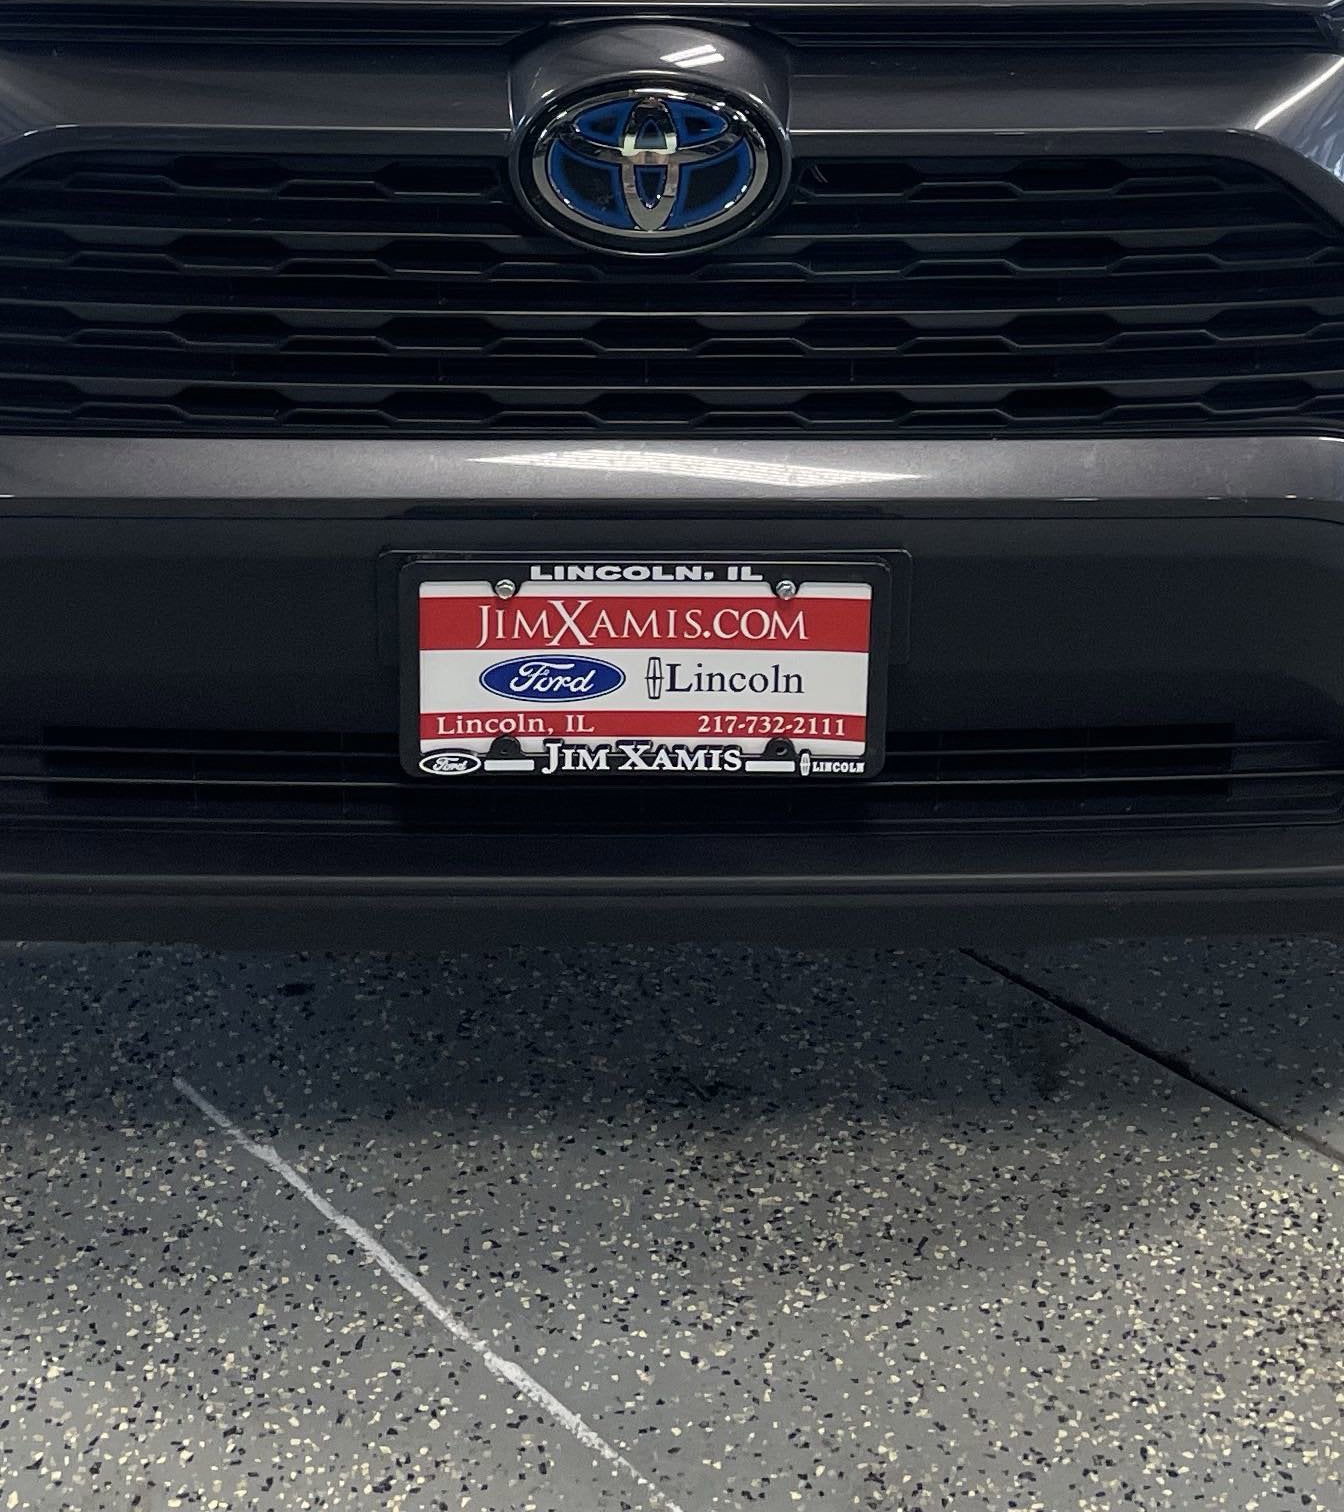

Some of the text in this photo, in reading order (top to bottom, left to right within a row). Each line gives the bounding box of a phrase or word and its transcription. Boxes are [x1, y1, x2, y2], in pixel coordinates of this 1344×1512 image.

[531, 565, 763, 581] LINCOLN, IL
[476, 600, 808, 648] JIMXAMIS.COM
[510, 661, 597, 693] Ford
[665, 663, 805, 694] Lincoln
[437, 714, 595, 735] Lincoln, IL
[698, 715, 846, 736] 217-732-2111
[541, 742, 742, 774] JIM XAMIS
[812, 761, 865, 773] LINCOLN
